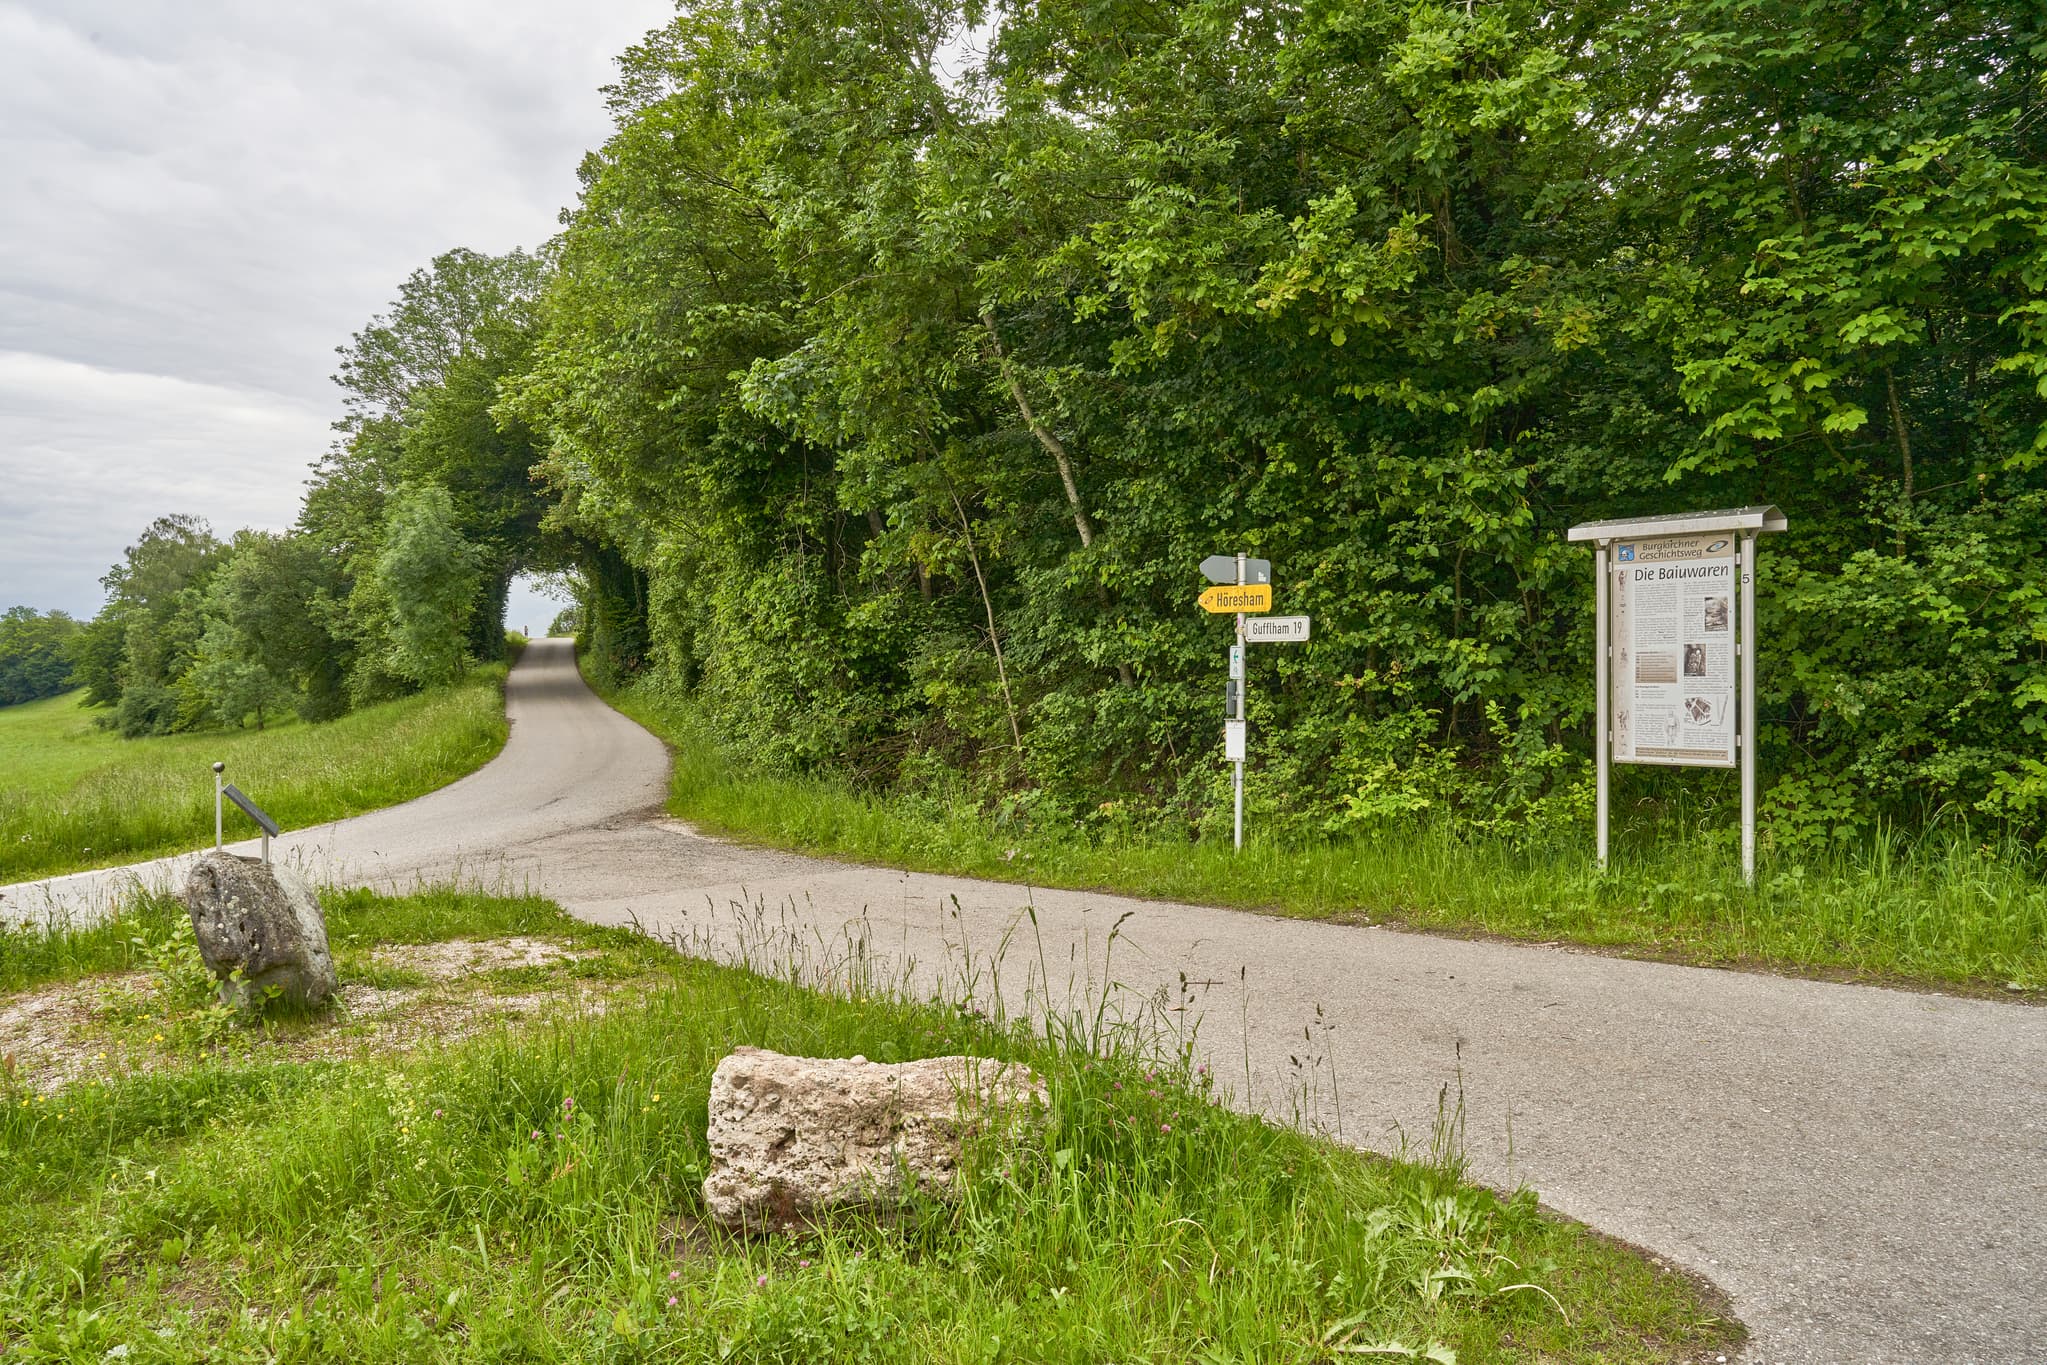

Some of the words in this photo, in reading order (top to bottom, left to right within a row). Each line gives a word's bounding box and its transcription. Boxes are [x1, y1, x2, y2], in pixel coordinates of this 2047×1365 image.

[1642, 540, 1699, 551] Burgkirchner
[1639, 548, 1703, 560] Geschichtsweg
[1634, 567, 1655, 582] Die
[1658, 565, 1729, 580] Baiuwaren
[1742, 574, 1750, 583] 5
[1216, 592, 1264, 607] Höresham
[1252, 622, 1290, 635] Gufflham
[1293, 621, 1303, 634] 19
